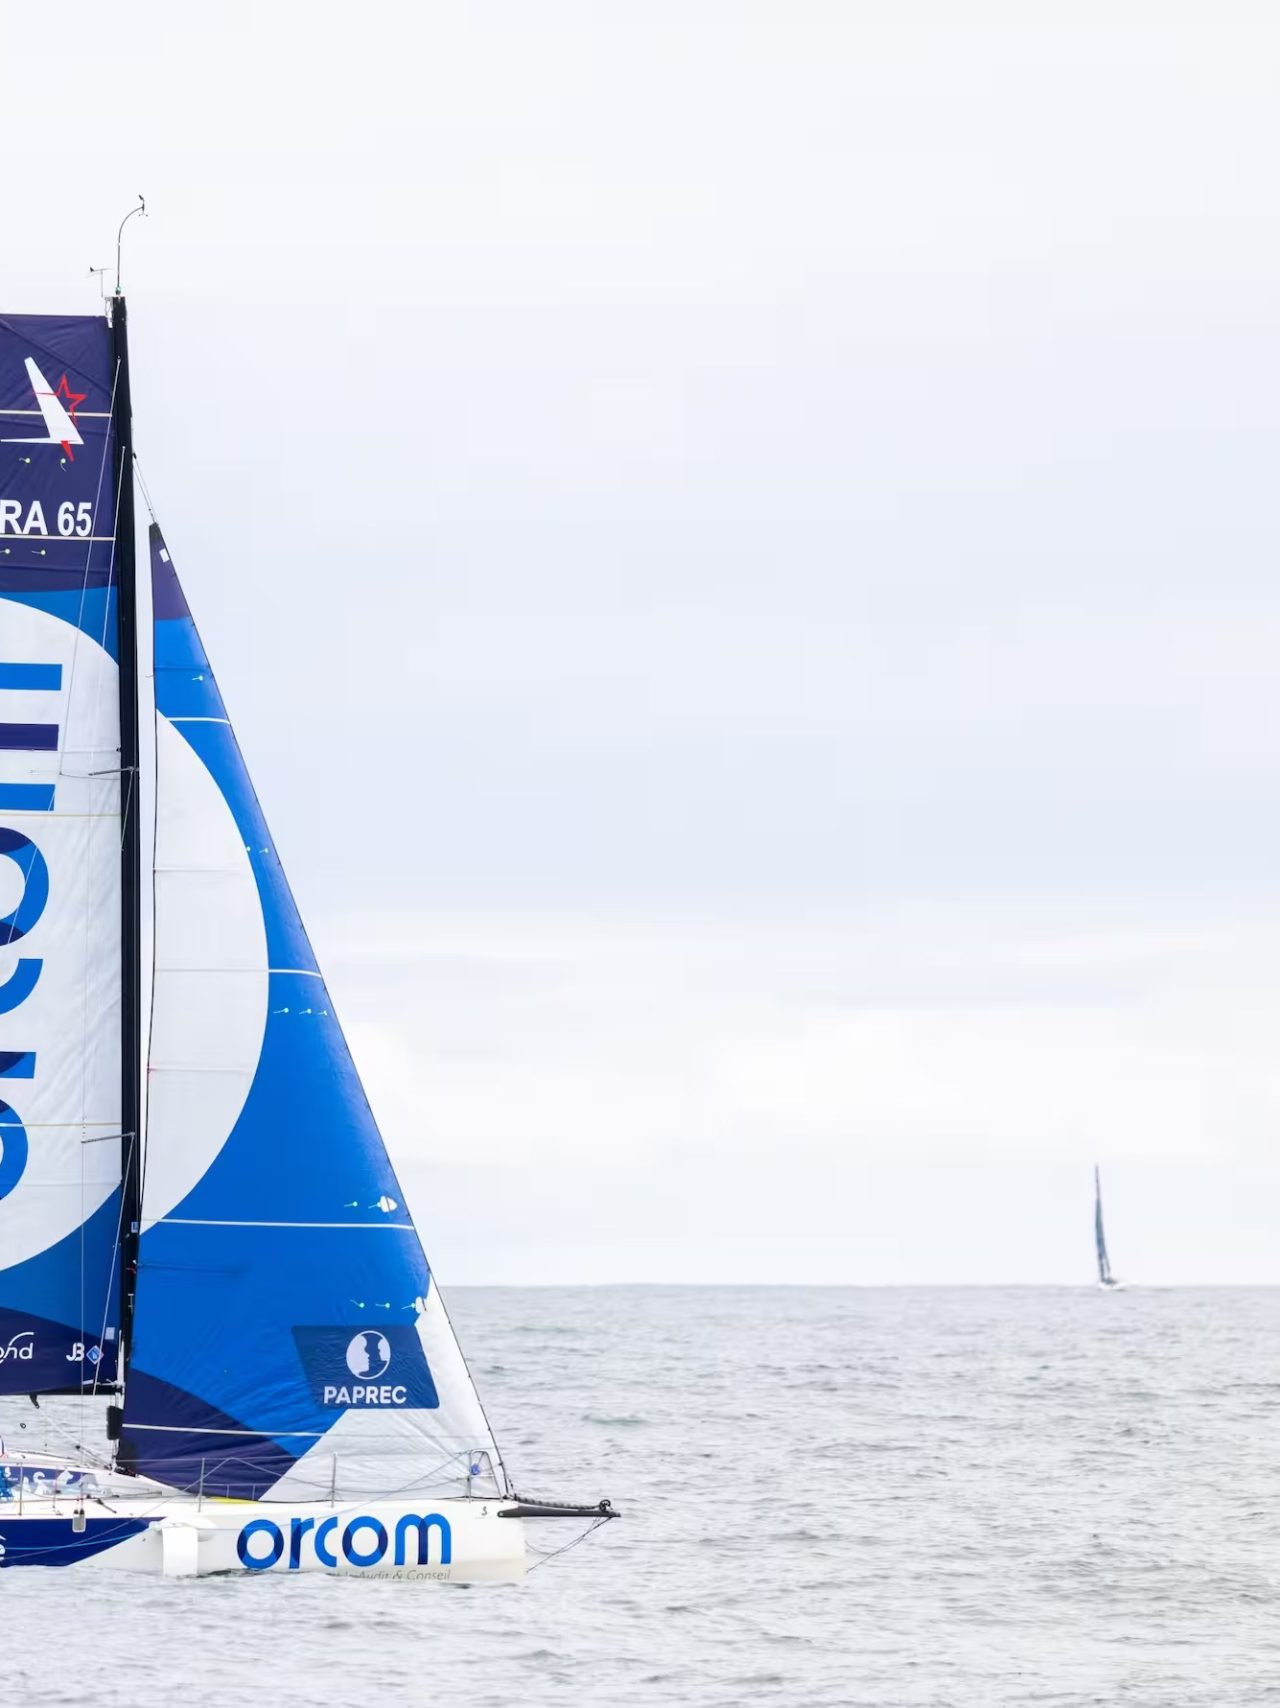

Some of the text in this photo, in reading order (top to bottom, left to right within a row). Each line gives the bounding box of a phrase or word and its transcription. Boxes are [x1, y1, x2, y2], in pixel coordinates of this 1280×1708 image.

[57, 502, 92, 536] 65
[323, 1386, 407, 1405] PAPREC
[237, 1513, 452, 1570] orcom
[406, 1569, 451, 1580] Conseil
